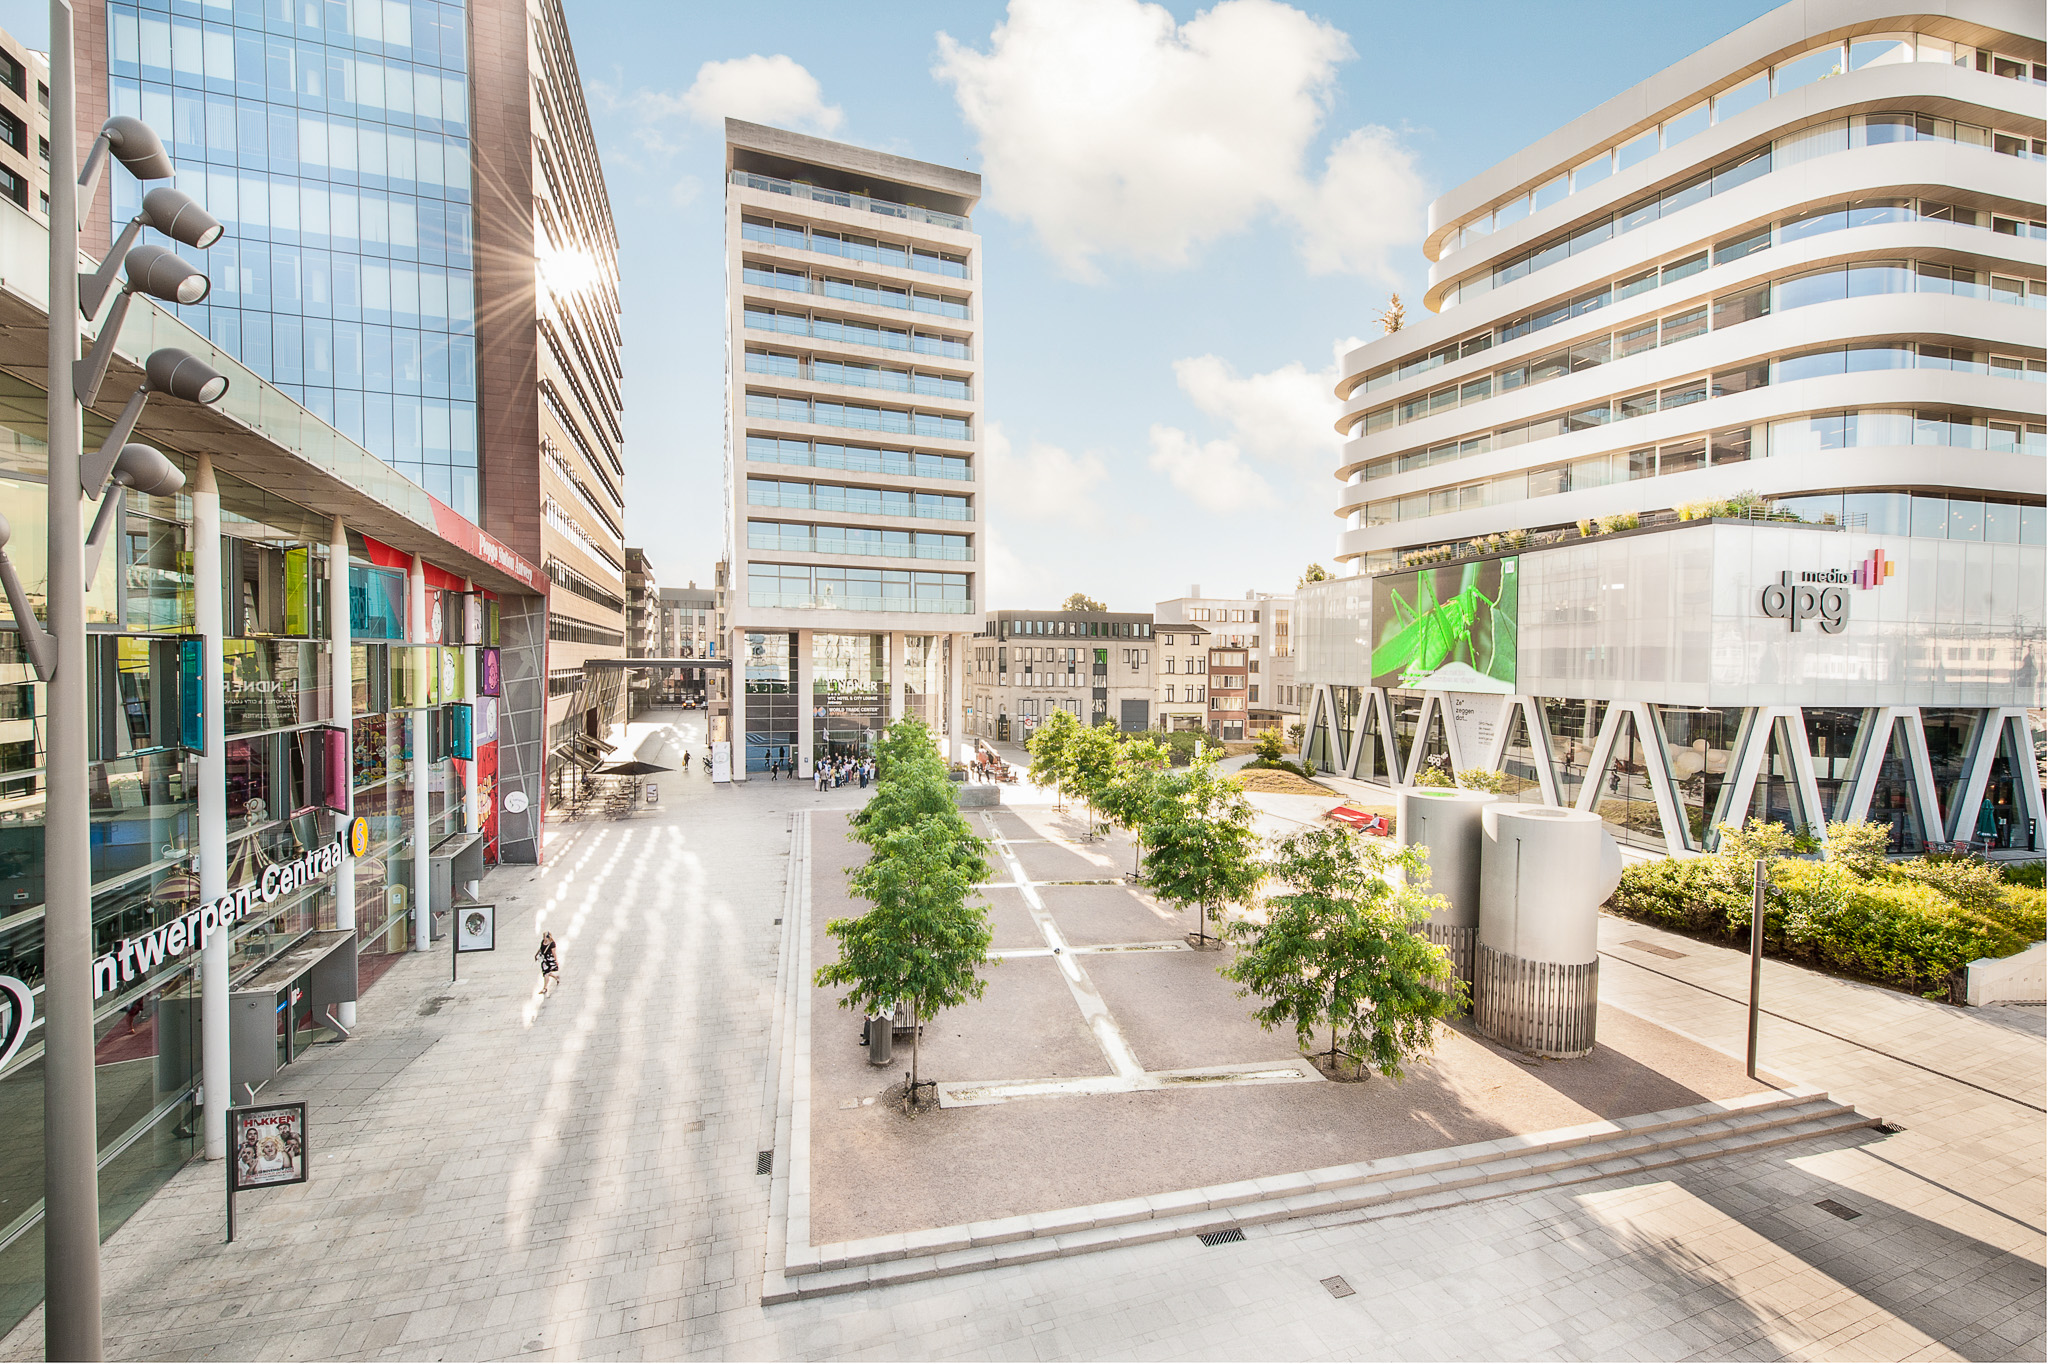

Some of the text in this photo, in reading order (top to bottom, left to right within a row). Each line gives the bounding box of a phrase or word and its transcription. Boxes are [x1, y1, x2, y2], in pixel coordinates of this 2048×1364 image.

[1801, 569, 1849, 583] media
[1762, 570, 1849, 634] dpg
[827, 681, 878, 691] LINDNER
[1427, 752, 1441, 766] dpg
[93, 829, 350, 1000] ntwerpen-Centraal
